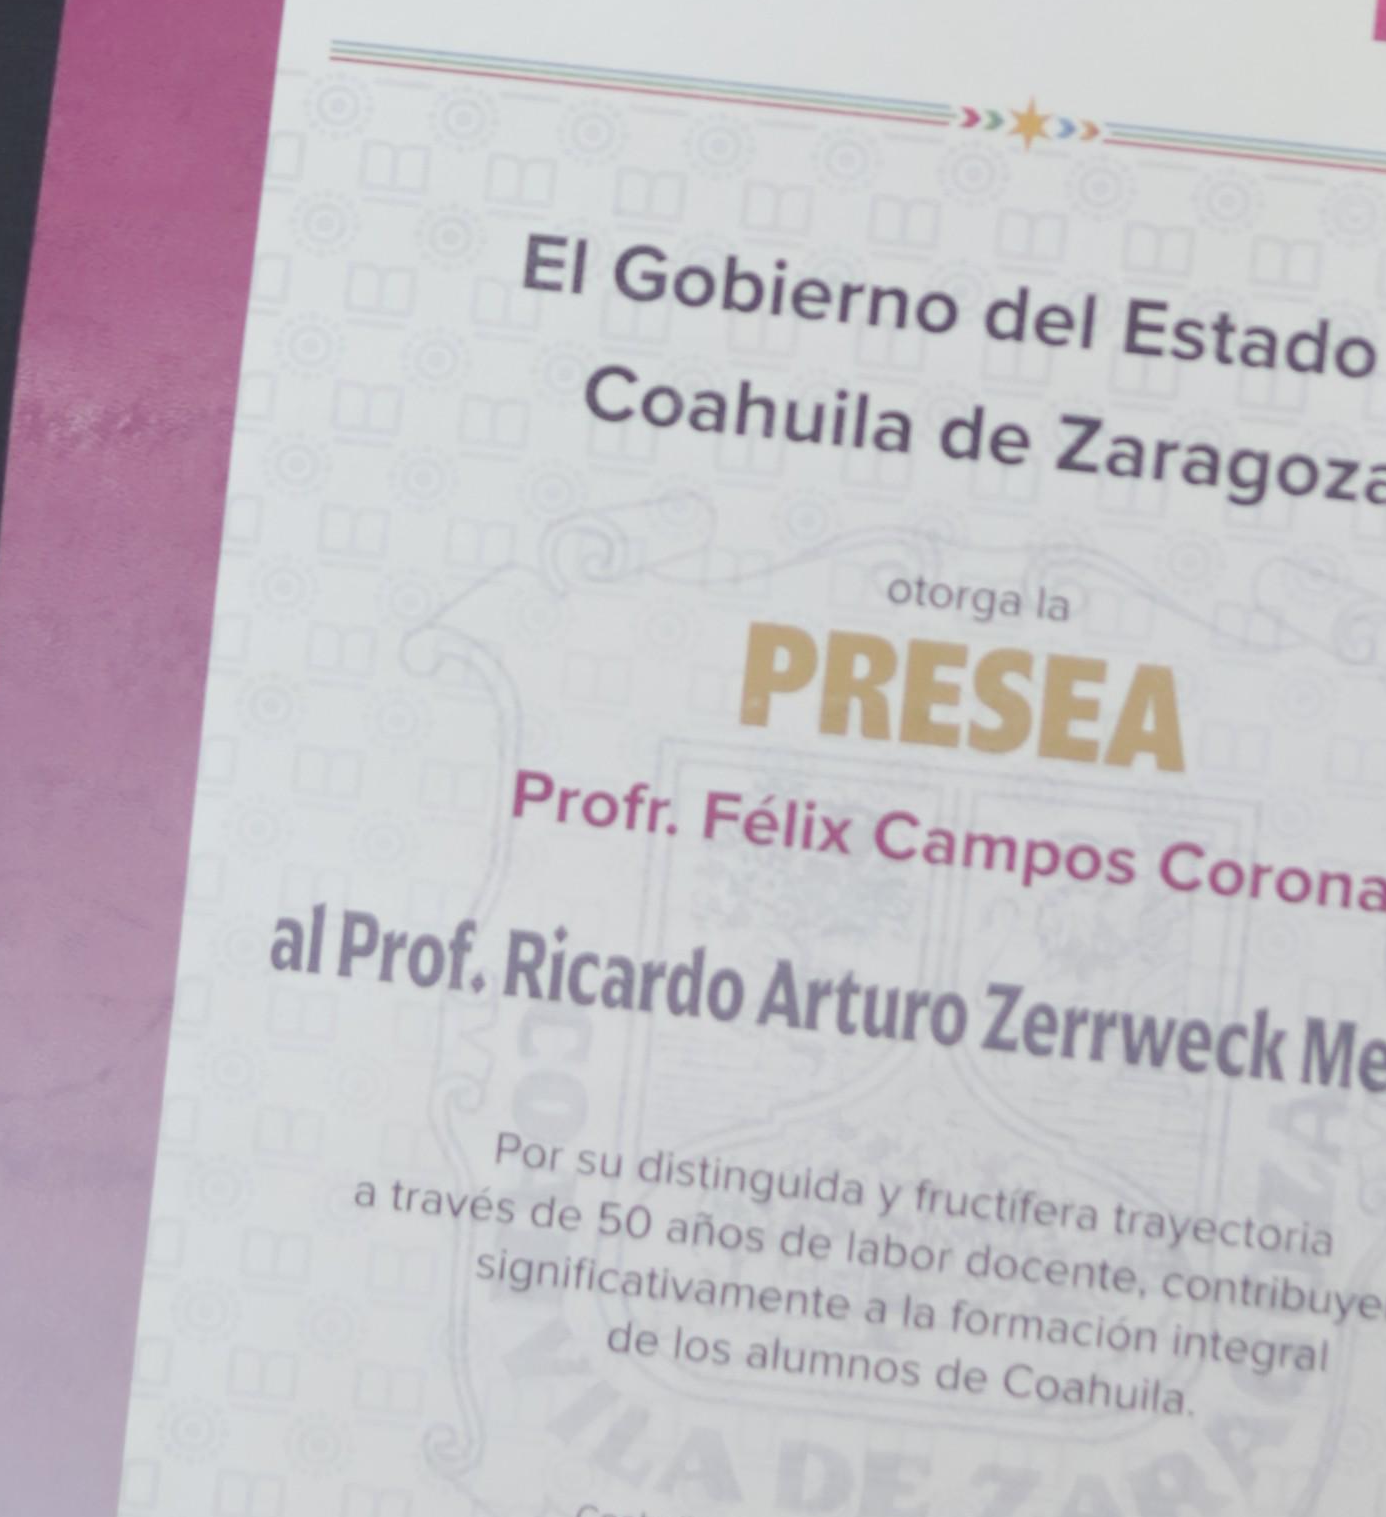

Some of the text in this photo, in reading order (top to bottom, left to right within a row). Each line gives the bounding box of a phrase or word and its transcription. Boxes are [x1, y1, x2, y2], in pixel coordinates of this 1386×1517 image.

[522, 233, 588, 295] El
[614, 244, 959, 334] Gobierno
[984, 286, 1097, 350] del
[1123, 298, 1377, 379] Estado
[584, 364, 913, 454] Coahuila
[940, 405, 1031, 466] de
[886, 575, 1071, 624] otorga la
[740, 622, 1186, 773] PRESEA
[512, 769, 678, 837] Profr.
[703, 791, 852, 855] Félix
[873, 810, 1136, 888] Campos
[270, 903, 326, 975] al
[337, 909, 486, 995] Prof.
[502, 925, 745, 1023] Ricardo
[755, 959, 968, 1048] Arturo
[981, 982, 1287, 1082] Zerrweck
[354, 1181, 376, 1208] a
[391, 1180, 515, 1225] través
[530, 1195, 582, 1232] de
[598, 1201, 652, 1240] 50
[666, 1211, 765, 1253] años
[779, 1223, 832, 1261] de
[847, 1230, 953, 1273] labor
[965, 1244, 1146, 1298] docente,
[495, 1131, 1334, 1257] Por su distinguida y fructífera trayectoria
[476, 1248, 1329, 1378] significativamente a la formación integral
[606, 1320, 1194, 1416] de los alumnos de Coahuila.
